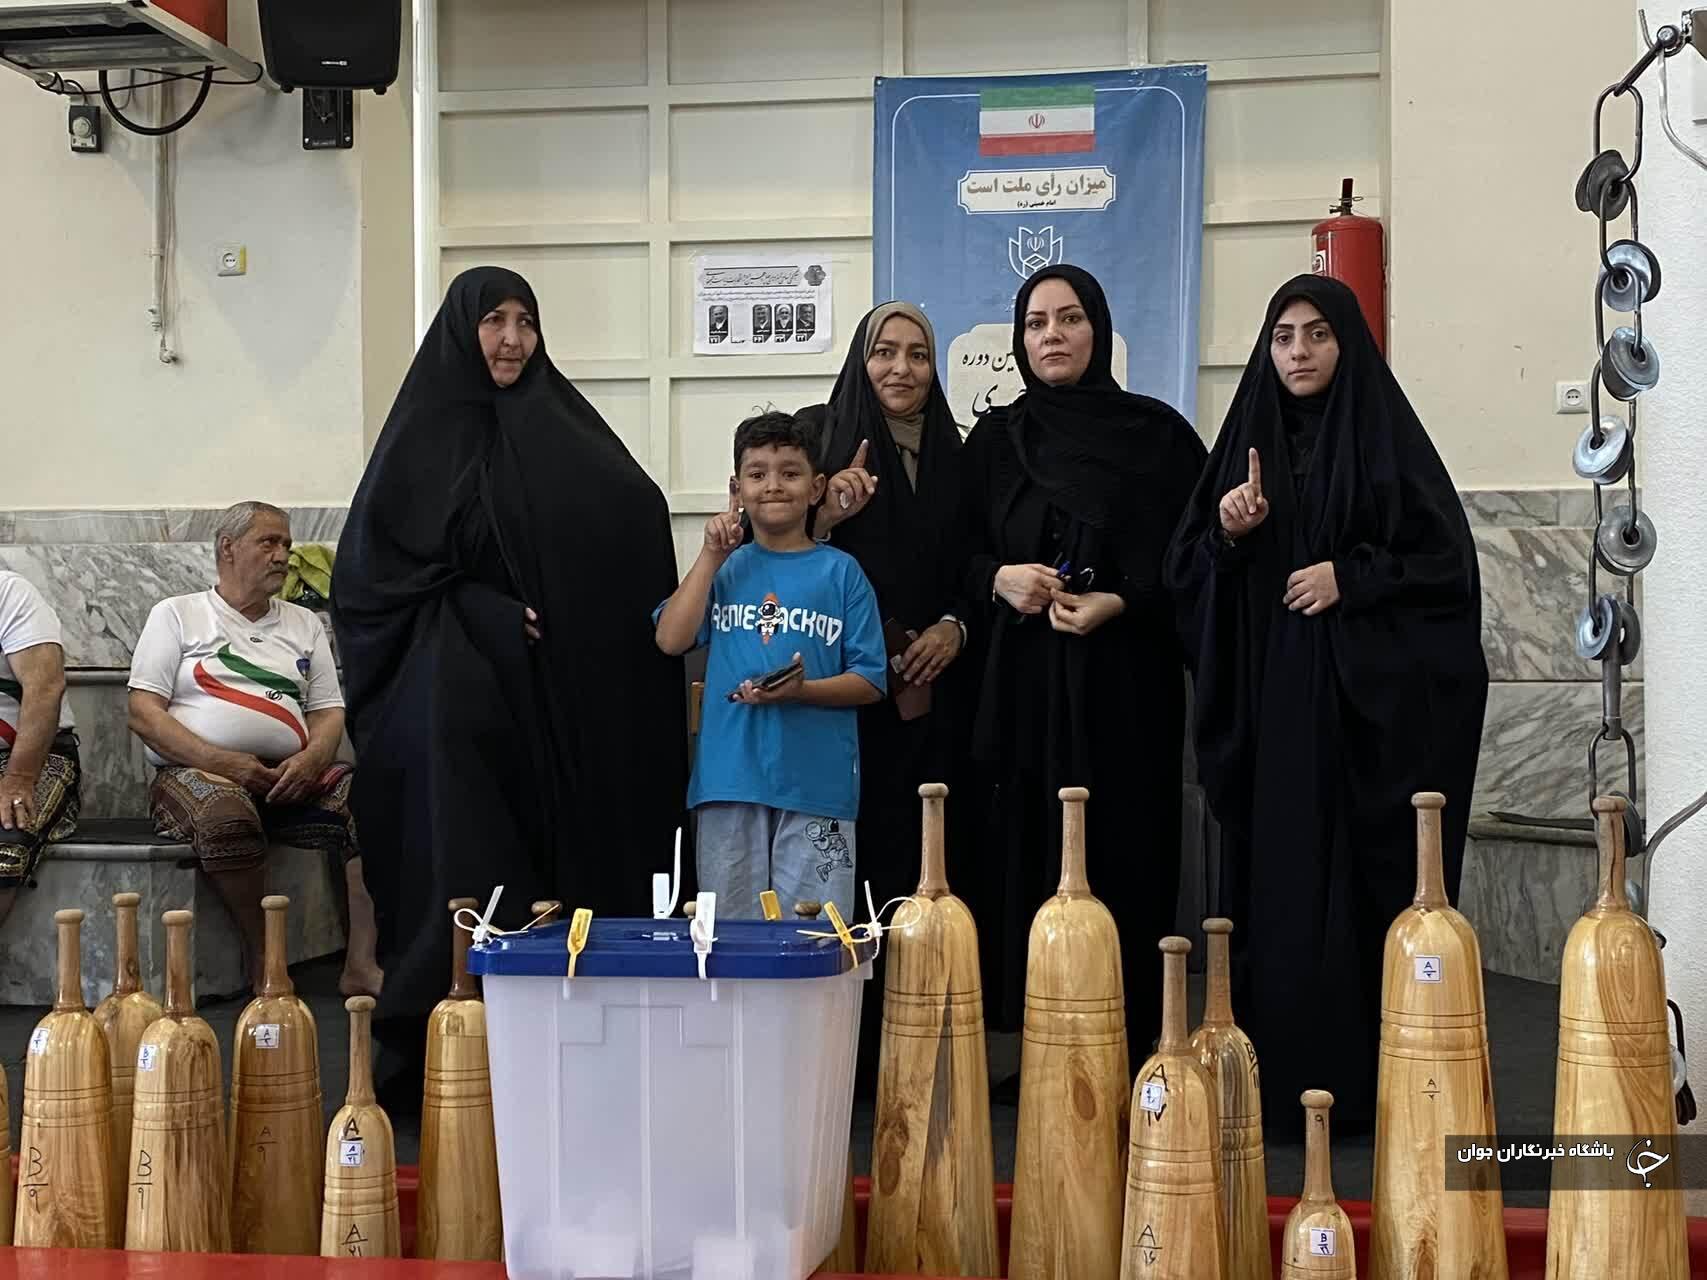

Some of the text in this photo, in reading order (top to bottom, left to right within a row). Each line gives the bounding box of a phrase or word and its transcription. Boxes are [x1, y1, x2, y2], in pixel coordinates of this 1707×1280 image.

[966, 177, 999, 194] است
[1002, 176, 1032, 193] ملت
[1066, 174, 1107, 195] میزان
[962, 353, 990, 366] دوره
[28, 1147, 43, 1178] B
[137, 1150, 152, 1177] B
[345, 1224, 361, 1243] A
[1137, 1224, 1156, 1246] A
